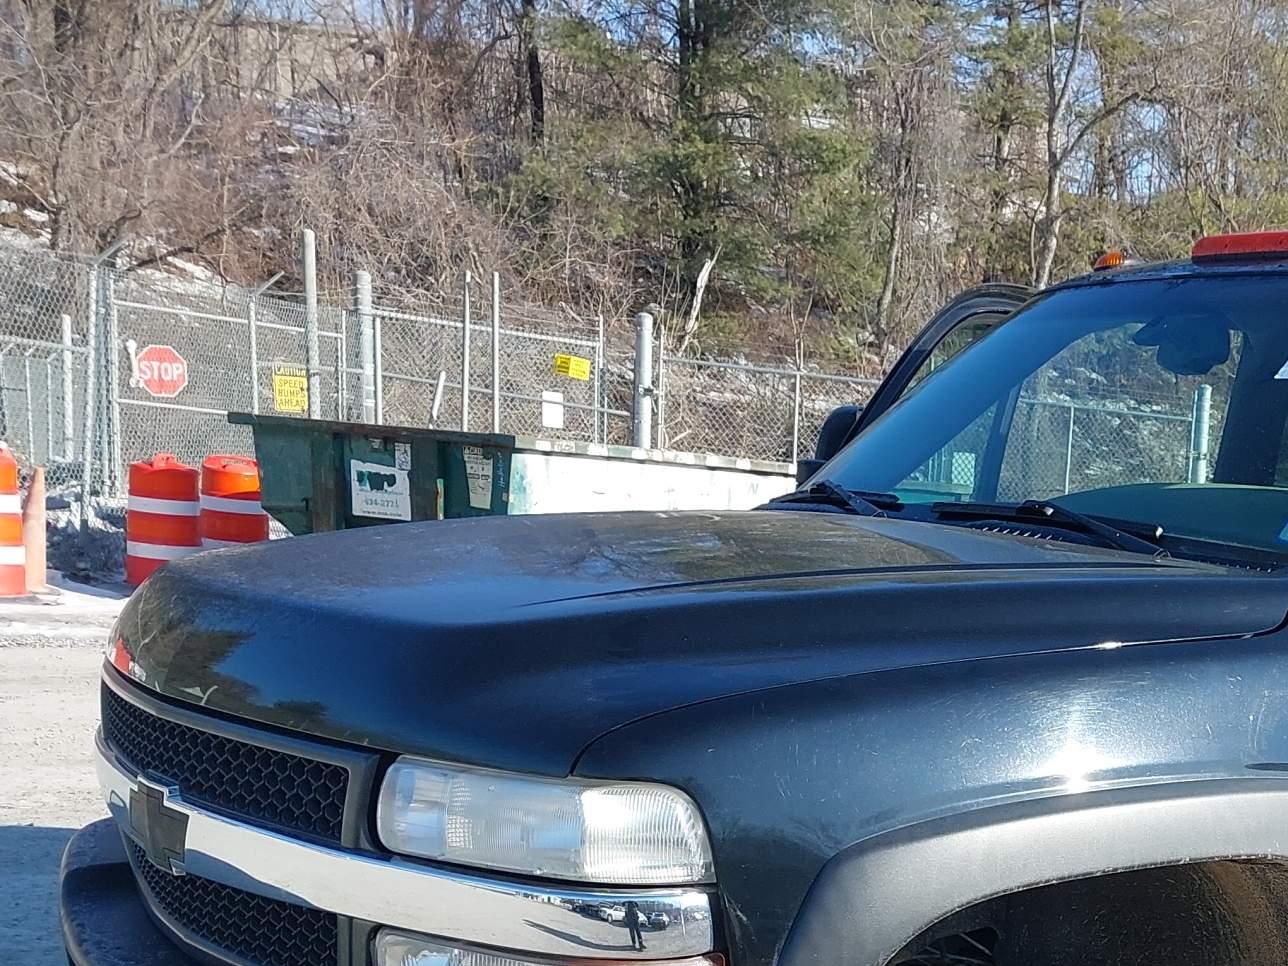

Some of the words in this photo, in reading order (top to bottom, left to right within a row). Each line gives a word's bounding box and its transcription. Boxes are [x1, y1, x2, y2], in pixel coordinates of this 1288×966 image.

[139, 360, 183, 381] STOP
[278, 378, 304, 389] SPEED
[278, 398, 306, 409] AHEAD
